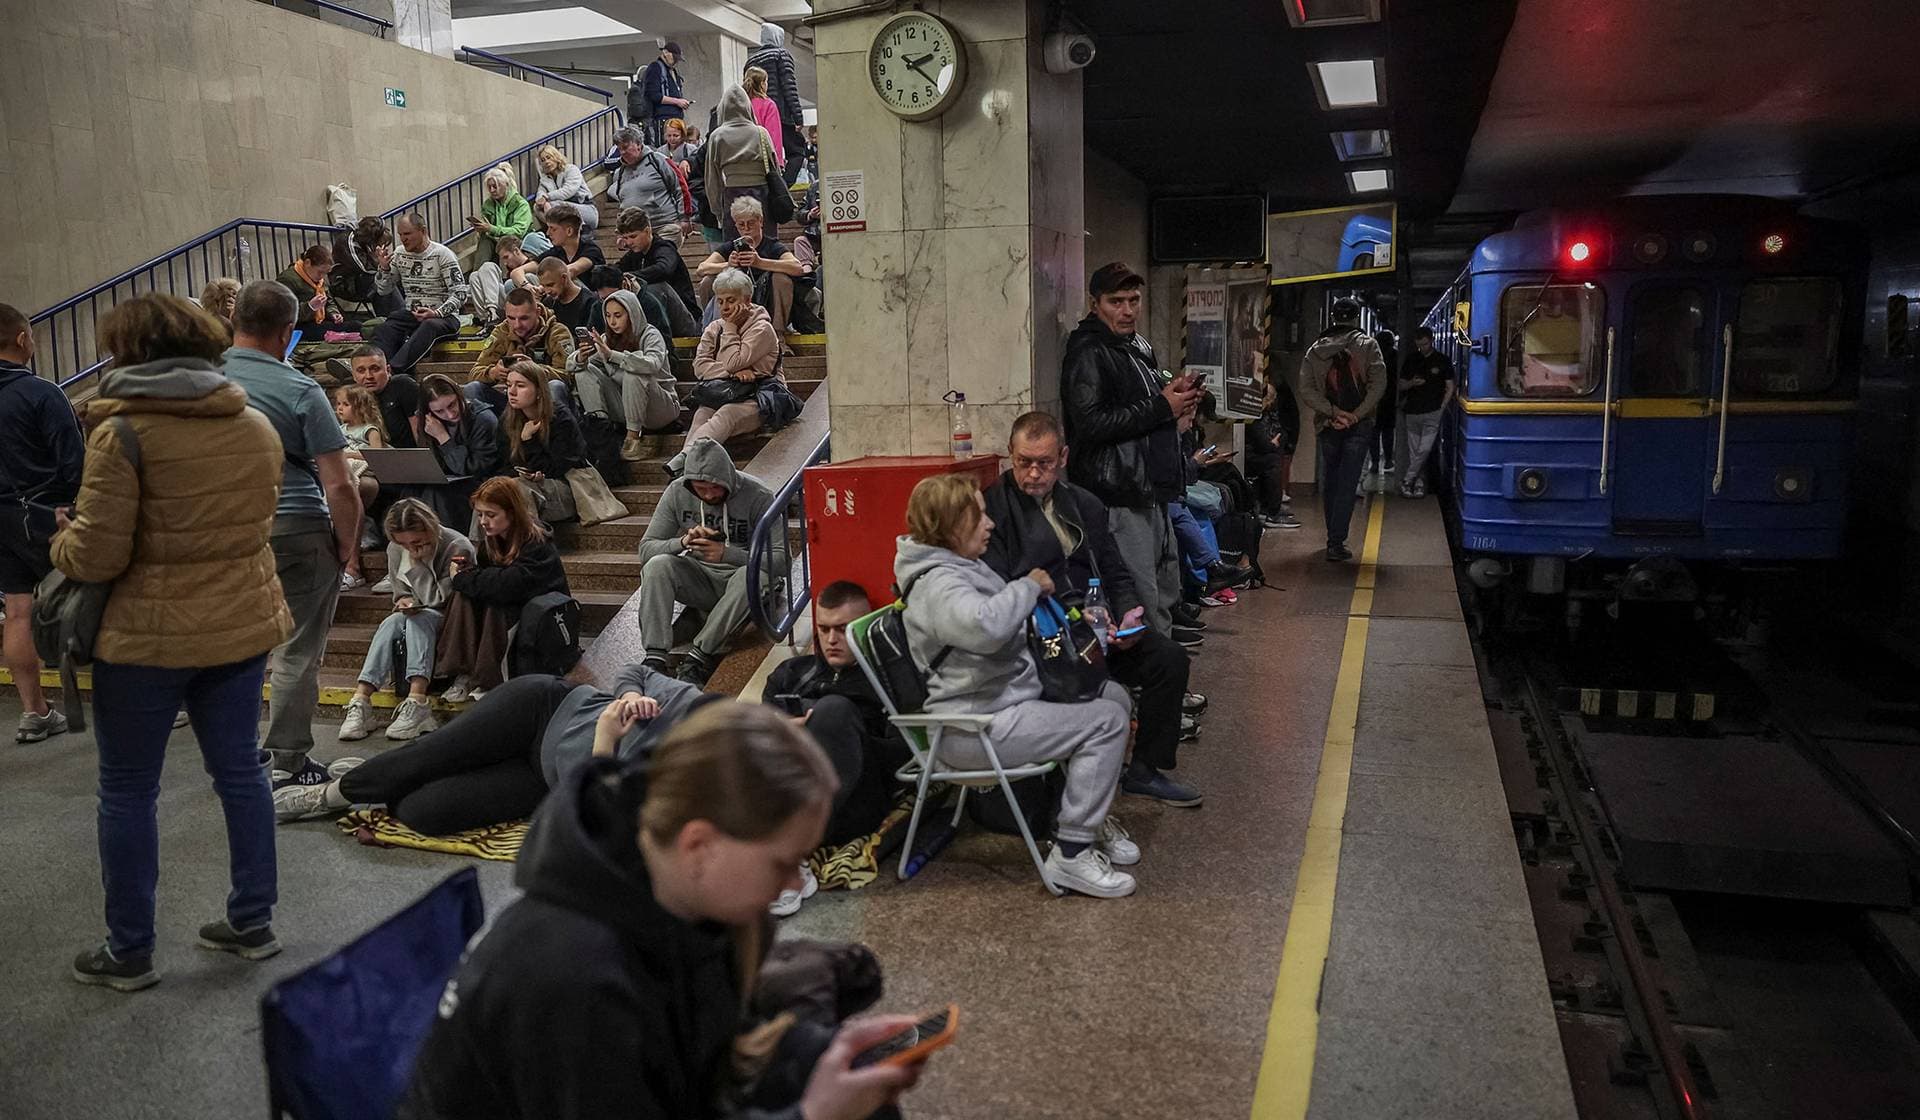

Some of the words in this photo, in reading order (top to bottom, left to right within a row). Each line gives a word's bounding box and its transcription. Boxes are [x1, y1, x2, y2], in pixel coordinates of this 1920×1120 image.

[905, 27, 916, 39] 12
[893, 33, 901, 46] 11
[933, 40, 940, 52] 2
[882, 47, 893, 59] 10
[940, 56, 947, 67] 3
[879, 64, 886, 75] 9
[886, 79, 893, 91] 8
[925, 85, 933, 97] 5
[897, 89, 904, 101] 7
[911, 92, 919, 103] 6
[1472, 536, 1497, 550] 7164
